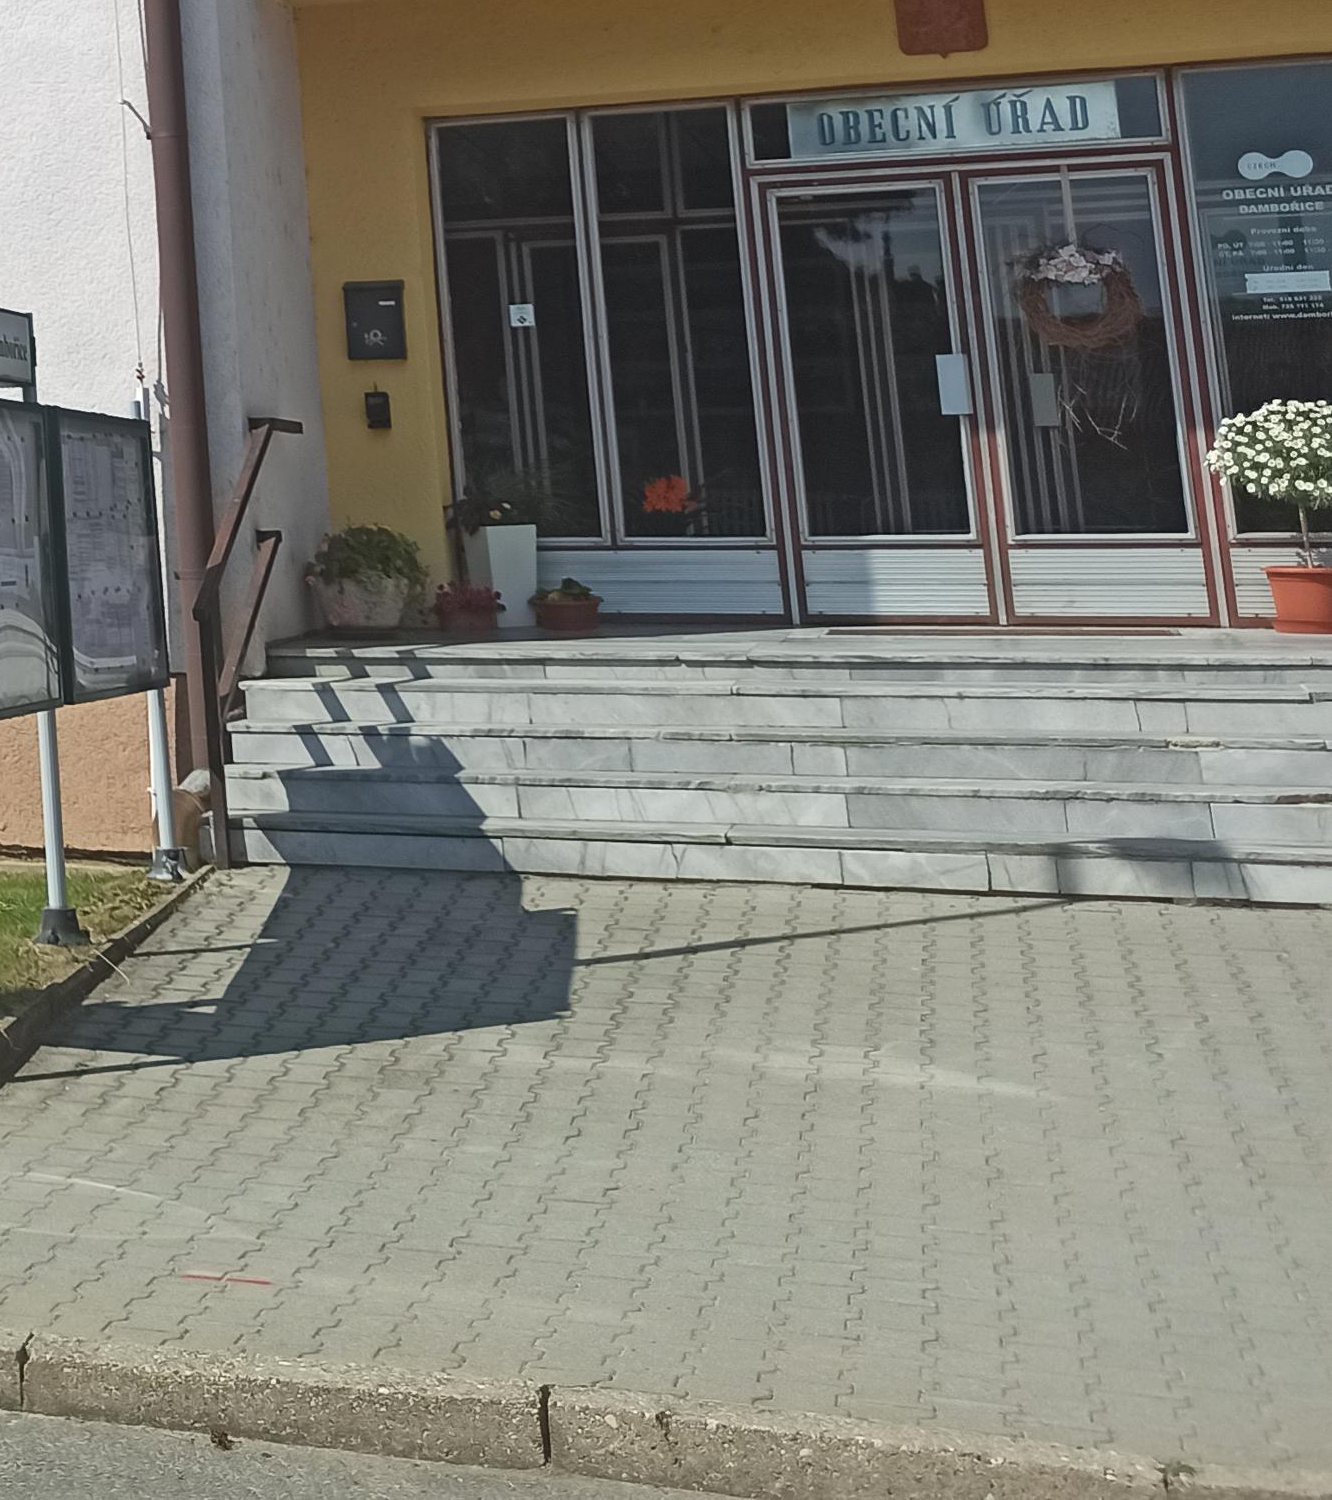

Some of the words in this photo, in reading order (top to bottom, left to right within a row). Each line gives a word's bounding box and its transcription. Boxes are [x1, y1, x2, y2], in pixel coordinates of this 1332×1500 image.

[817, 95, 960, 146] OBECNÍ
[982, 89, 1090, 137] ÚŘAD
[1222, 185, 1285, 200] OBECNÍ
[1239, 200, 1325, 214] DAMBOŘICE
